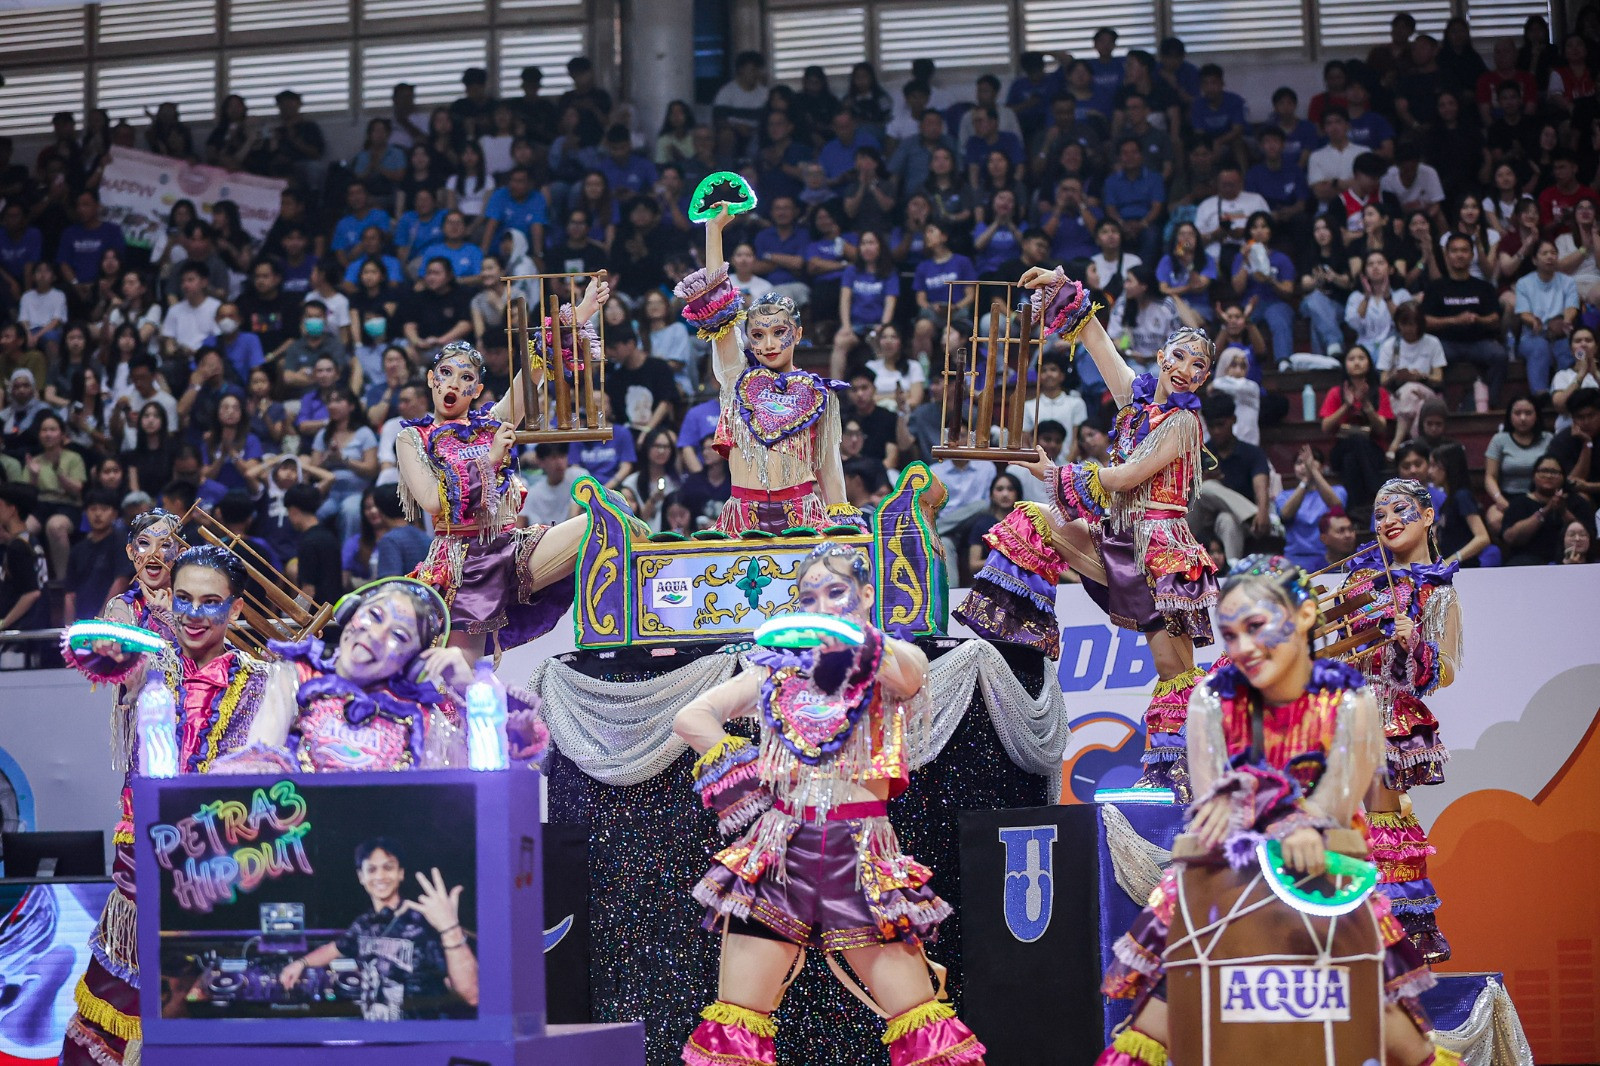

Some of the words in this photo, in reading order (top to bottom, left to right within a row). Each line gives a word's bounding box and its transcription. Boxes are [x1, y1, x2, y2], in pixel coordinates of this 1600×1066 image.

[656, 580, 689, 593] AQUA
[149, 780, 307, 870] PETRA3
[172, 821, 314, 912] HIPDUT
[1223, 967, 1346, 1018] AQUA
